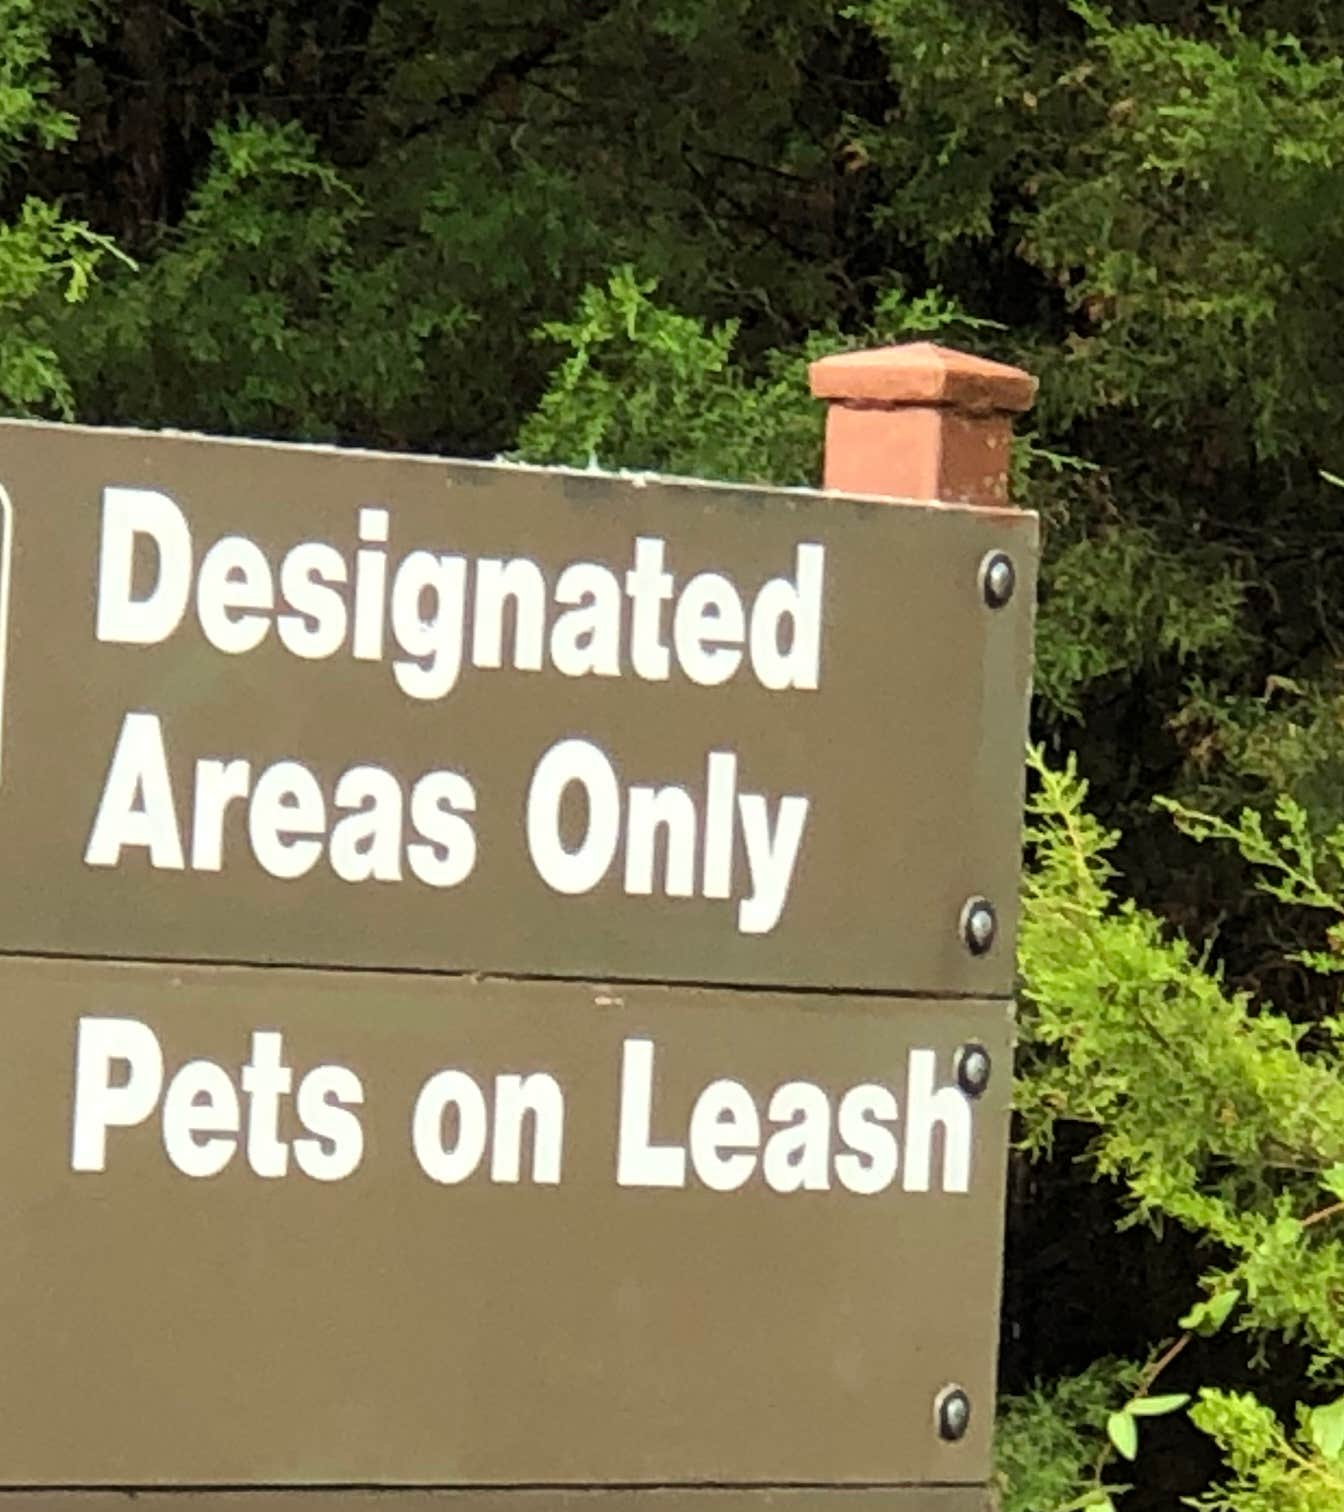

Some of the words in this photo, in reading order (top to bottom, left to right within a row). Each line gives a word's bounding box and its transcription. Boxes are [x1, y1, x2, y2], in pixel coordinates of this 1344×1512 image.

[95, 485, 826, 701] Designated
[83, 711, 478, 888] Areas
[526, 737, 812, 934] Only
[70, 1015, 365, 1184] Pets
[411, 1068, 565, 1188] on
[615, 1037, 974, 1198] Leash
